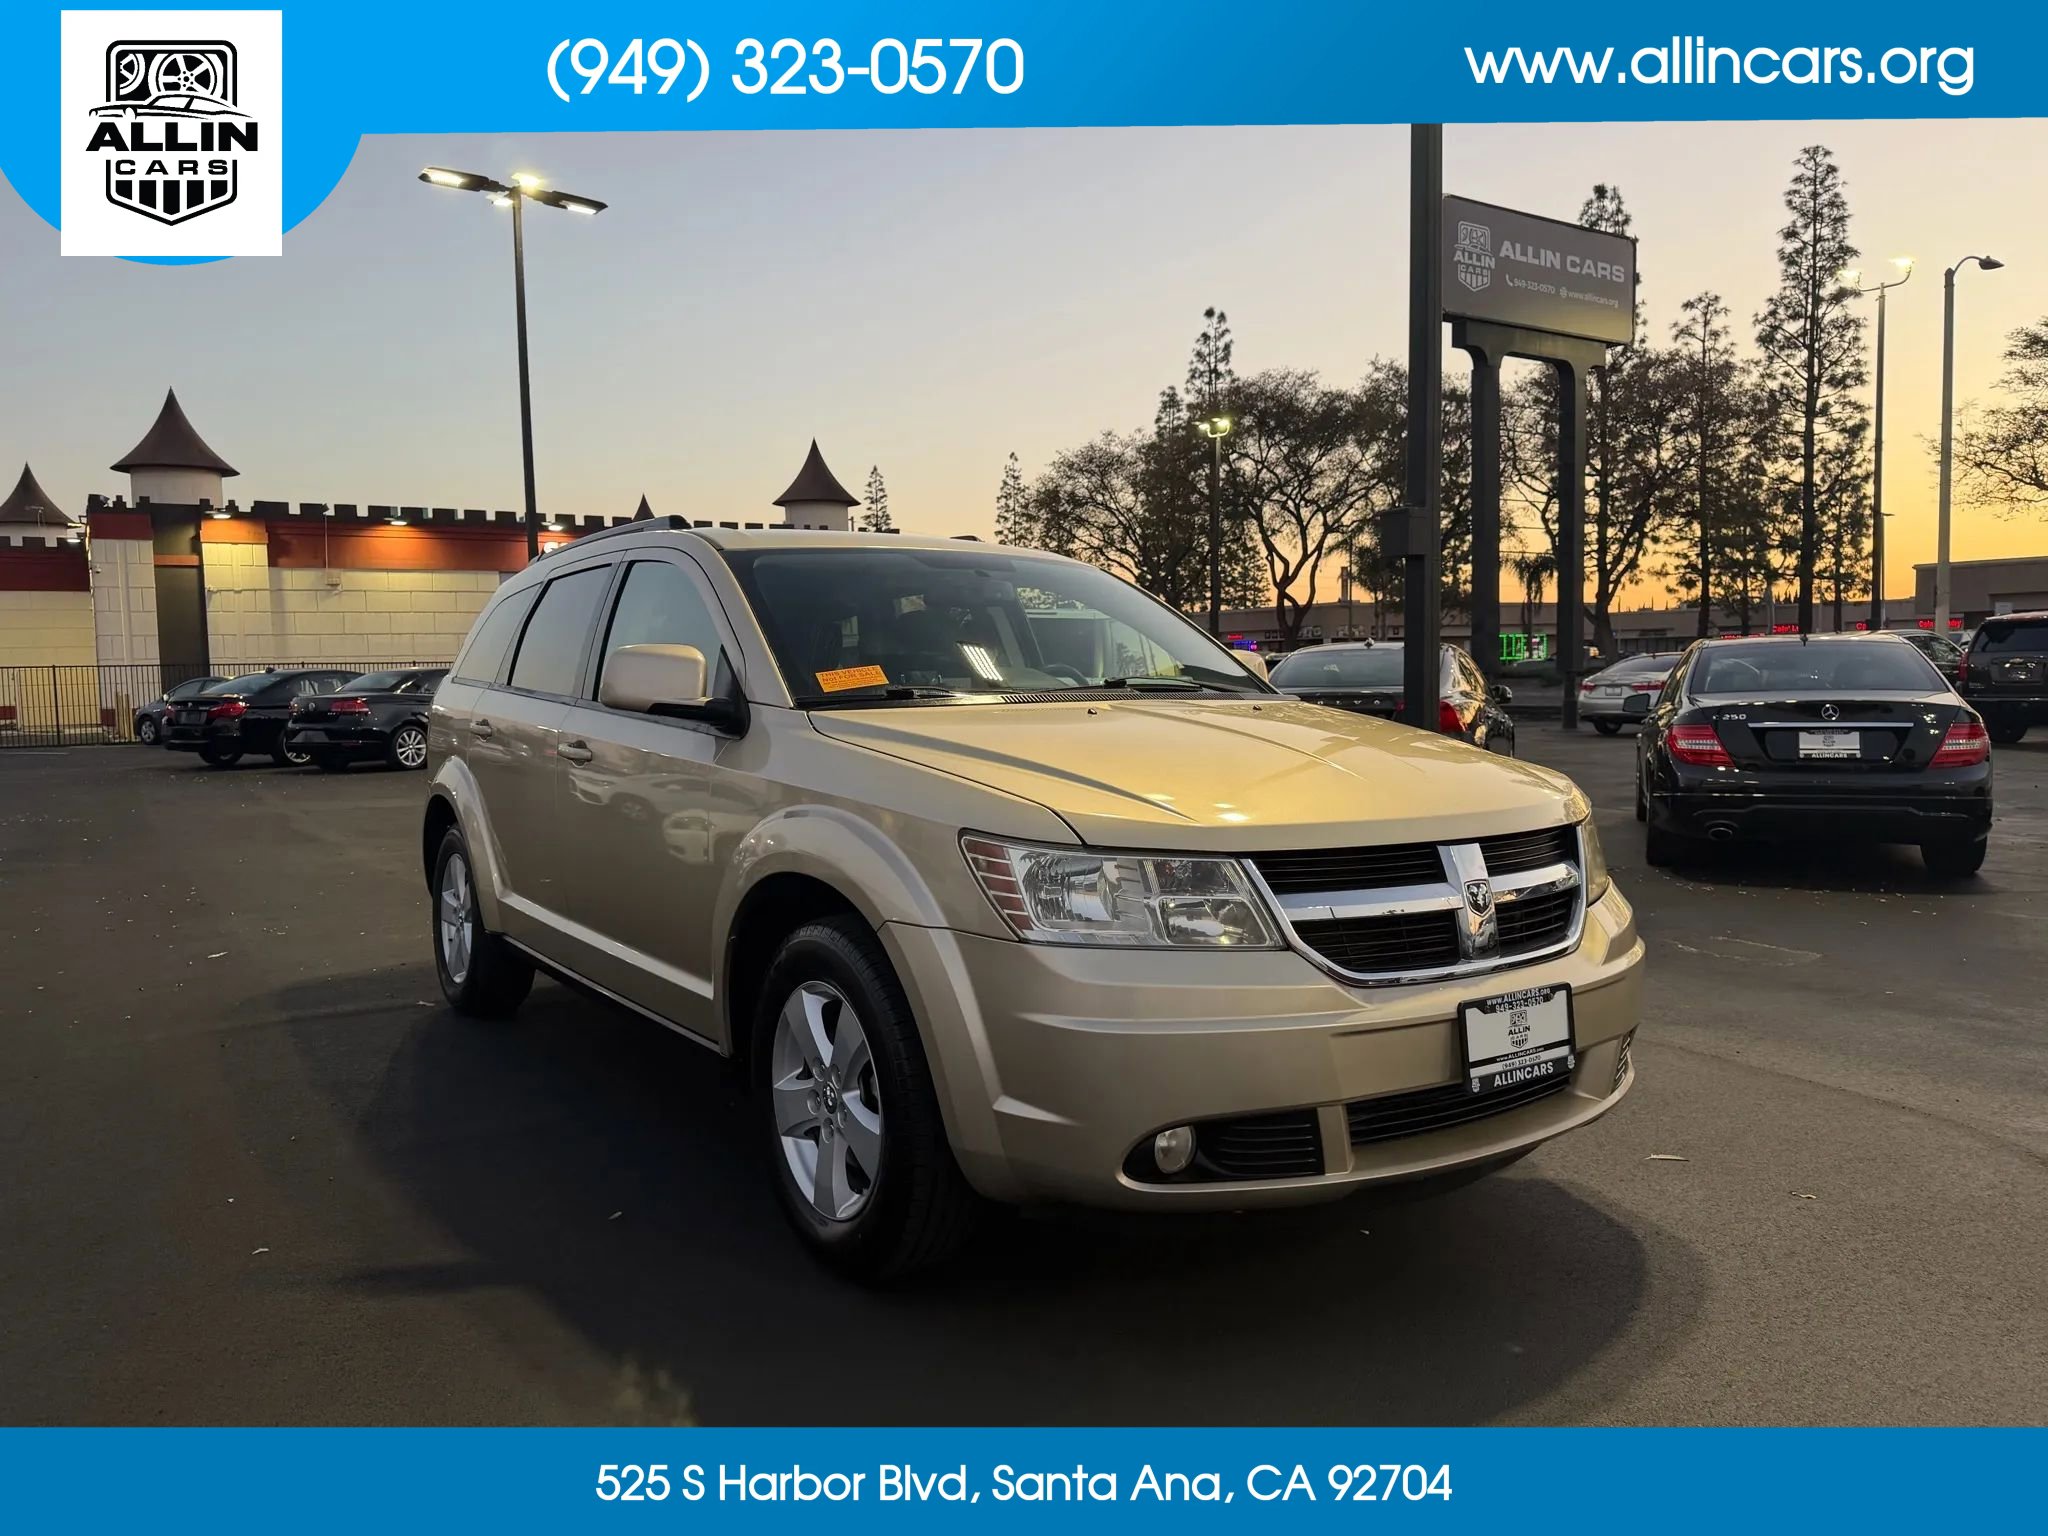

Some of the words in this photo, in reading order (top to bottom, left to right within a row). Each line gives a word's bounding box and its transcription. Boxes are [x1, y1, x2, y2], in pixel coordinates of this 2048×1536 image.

[1453, 250, 1496, 270] ALLIN
[1500, 240, 1561, 270] ALLIN
[1566, 255, 1625, 283] CARS
[1508, 1025, 1531, 1036] ALLIN
[1493, 1061, 1554, 1088] ALLINCARS
